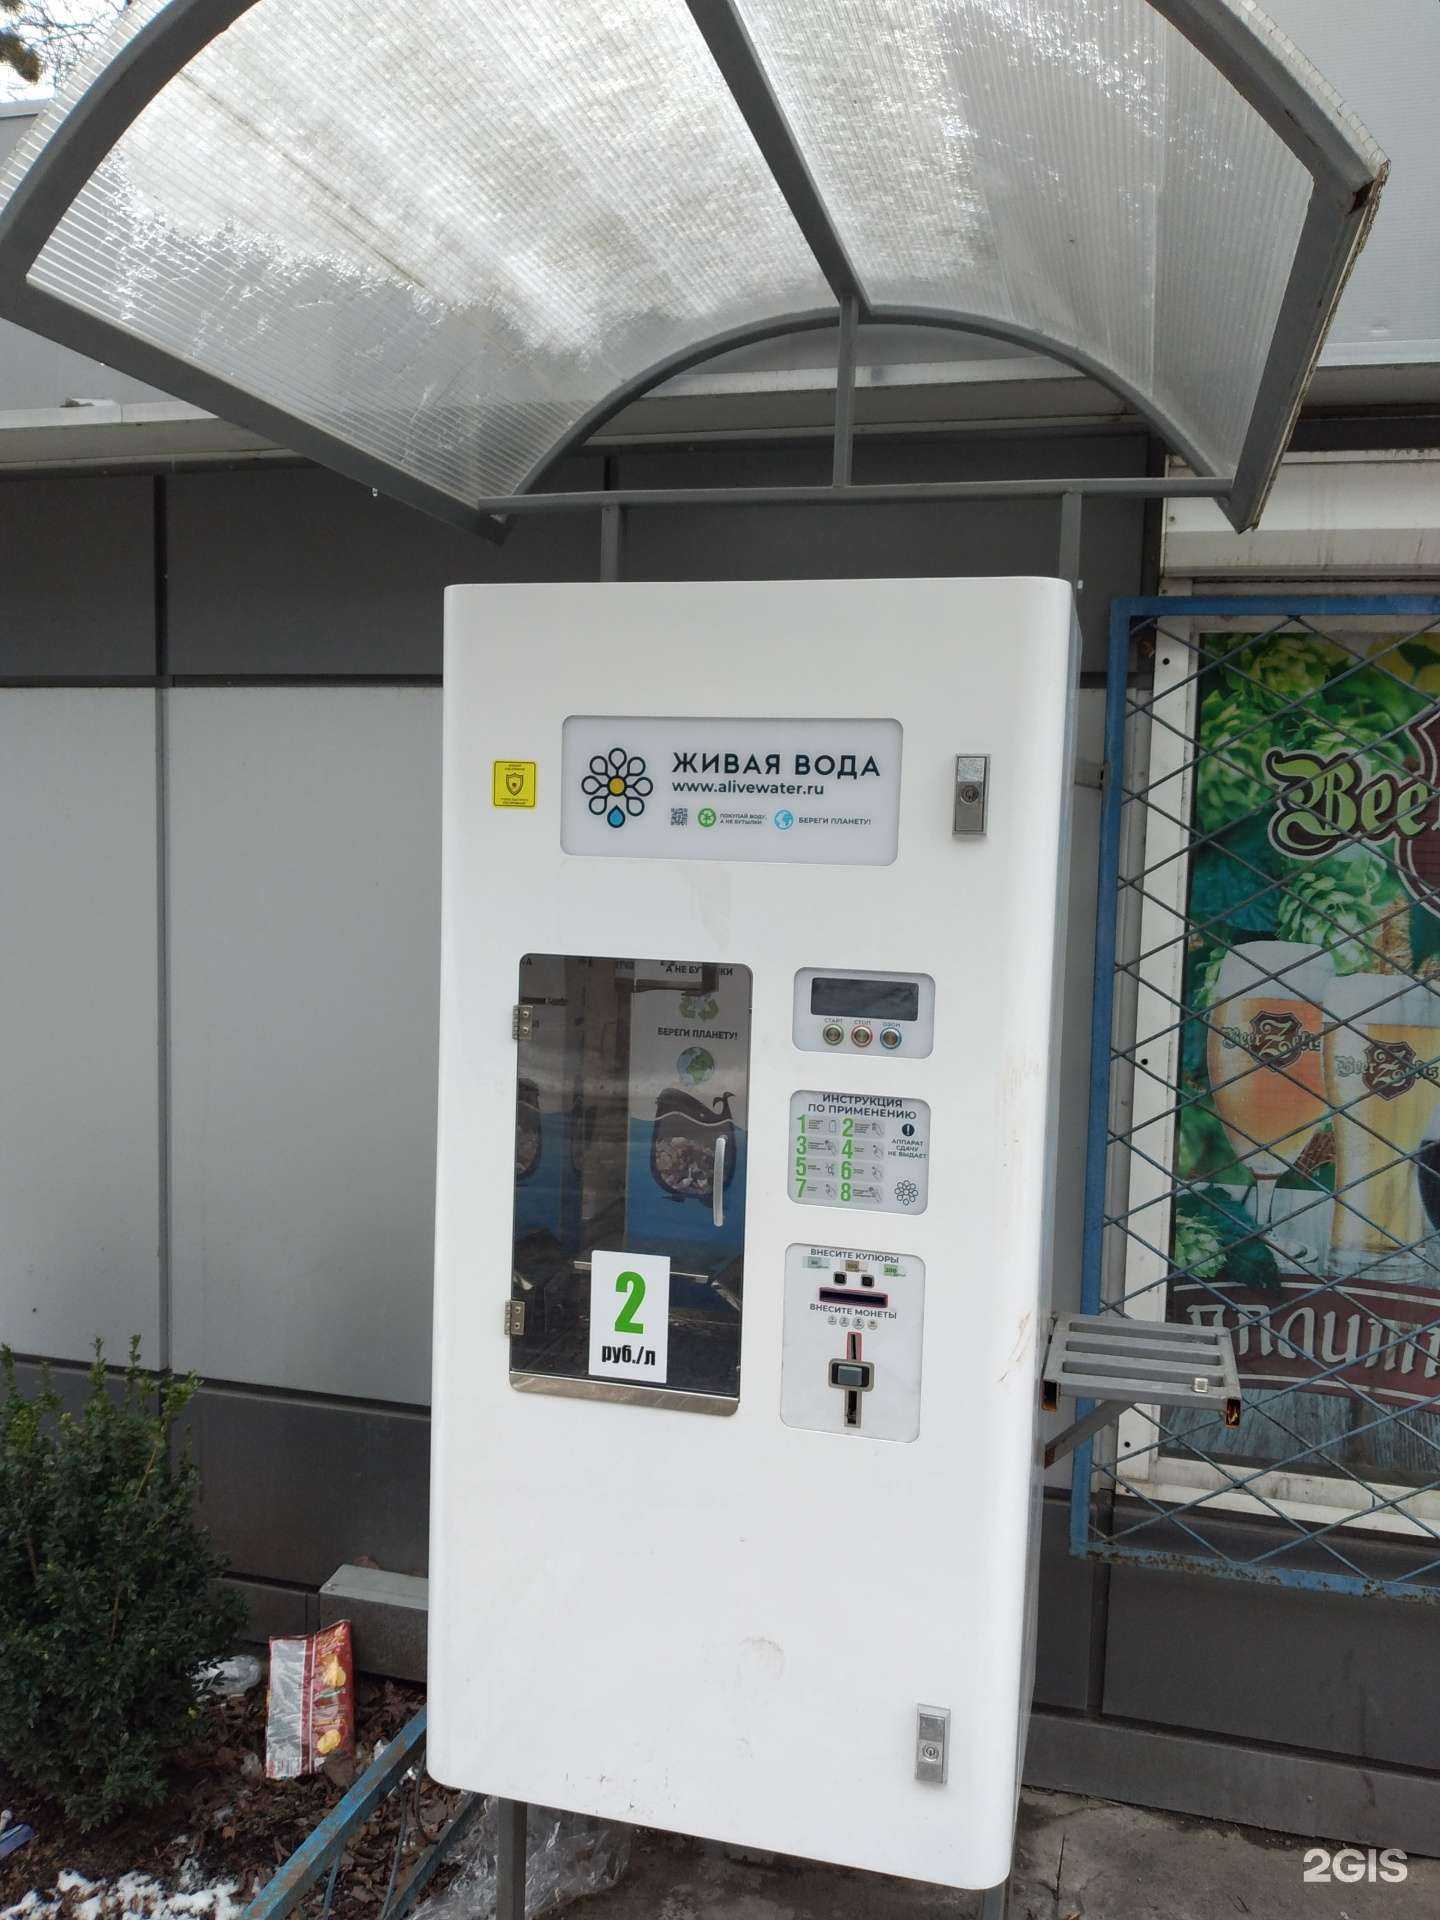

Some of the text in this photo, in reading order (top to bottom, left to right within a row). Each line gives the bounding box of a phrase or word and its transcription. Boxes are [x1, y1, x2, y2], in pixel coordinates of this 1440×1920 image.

[672, 752, 881, 780] ЖИВАЯ ВОДА
[672, 780, 824, 795] www.alivewater.ru
[798, 816, 871, 826] БЕРЕГИ ПЛАНЕТУ!
[665, 965, 673, 973] А
[675, 965, 687, 974] НЕ
[657, 1026, 738, 1041] БЕРЕГИ ПЛАНЕТУ!
[822, 1094, 903, 1108] ИНСТРУКЦИЯ
[808, 1103, 917, 1120] ПО ПРИМЕНЕНИЮ
[797, 1114, 806, 1134] 1
[842, 1118, 854, 1137] 2
[797, 1136, 807, 1155] 3
[841, 1139, 853, 1159] 4
[891, 1138, 924, 1147] АППАРАТ
[796, 1157, 806, 1176] 5
[841, 1161, 852, 1180] 6
[795, 1179, 807, 1198] 7
[840, 1183, 851, 1201] 8
[810, 1248, 900, 1263] ВНЕСИТЕ КУПЮРЫ
[614, 1271, 646, 1334] 2
[809, 1303, 897, 1319] ВНЕСИТЕ МОНЕТЫ
[601, 1345, 656, 1366] руб./л
